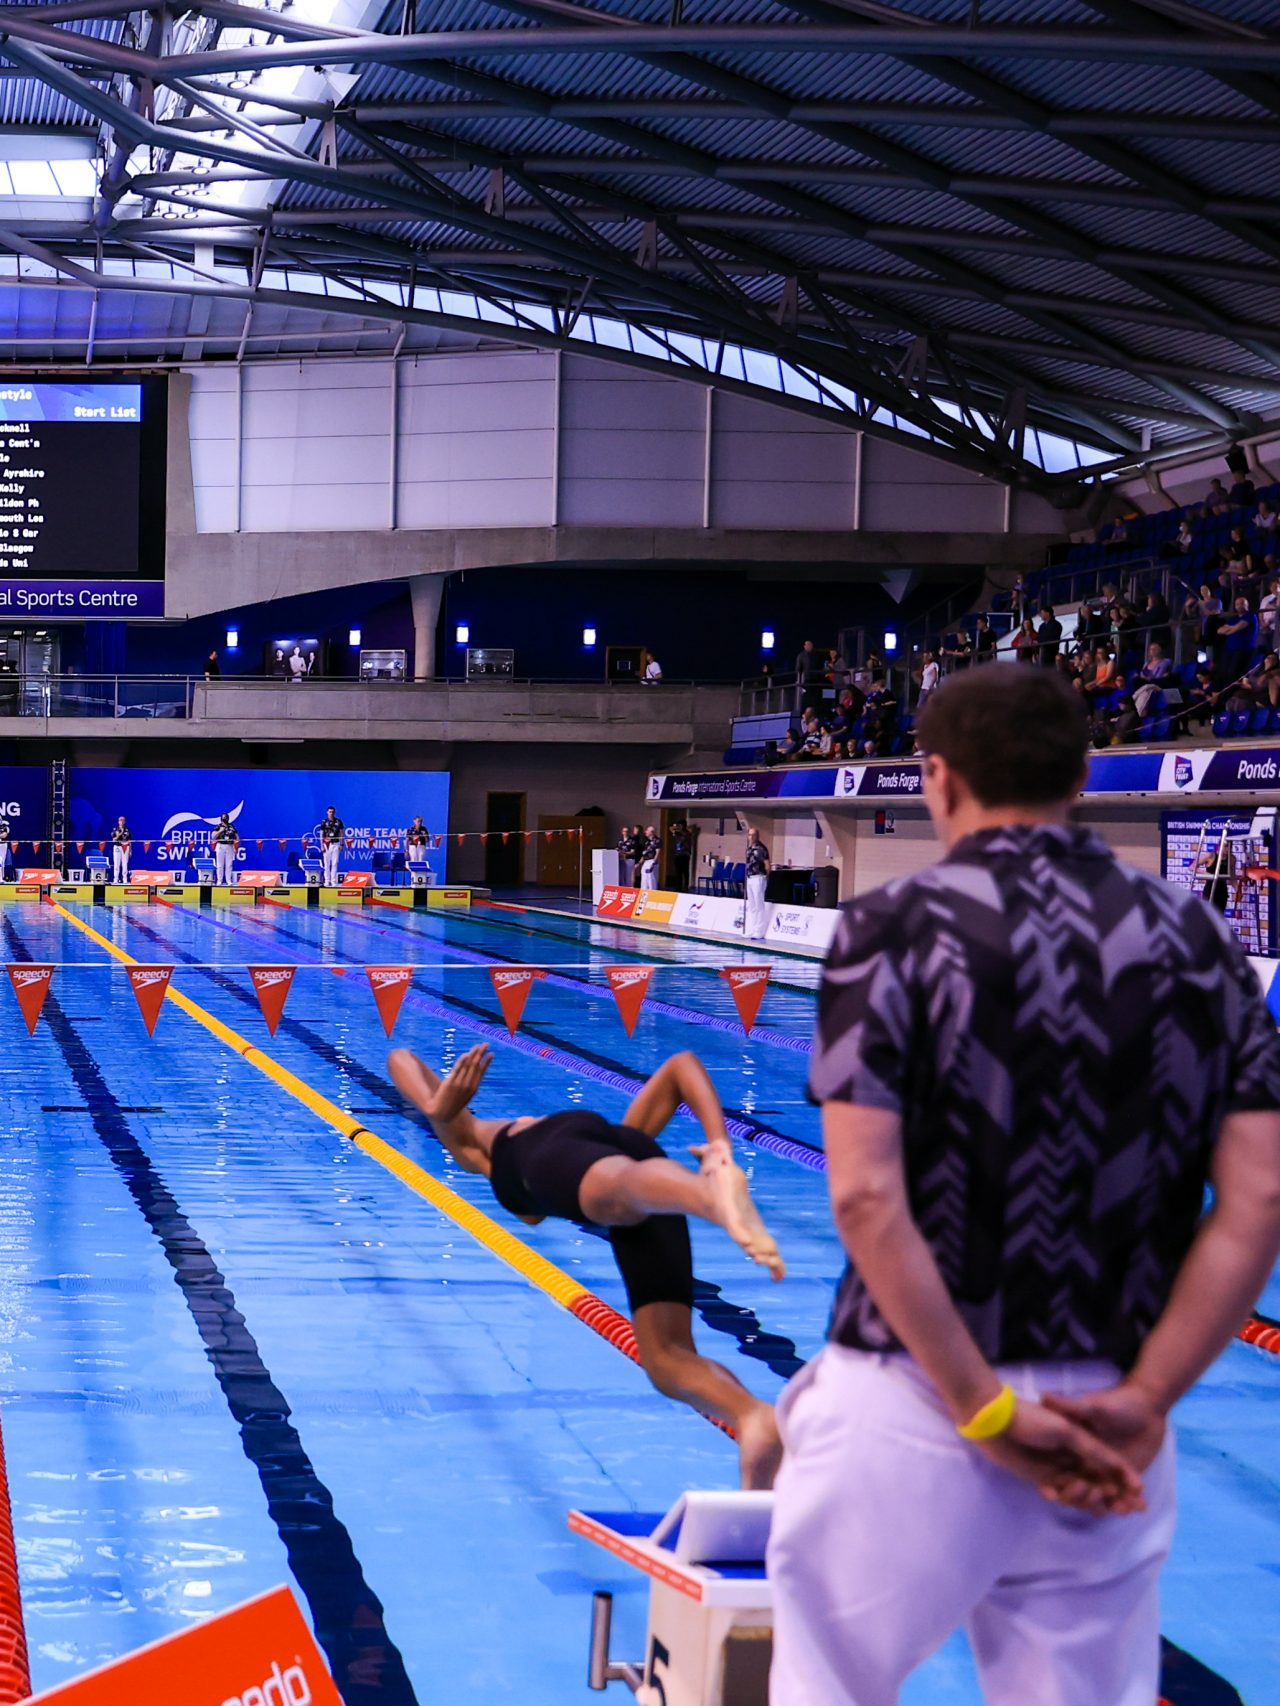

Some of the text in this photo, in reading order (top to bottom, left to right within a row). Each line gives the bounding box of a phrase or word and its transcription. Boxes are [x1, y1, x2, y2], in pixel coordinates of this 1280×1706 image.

[74, 406, 136, 417] Start List
[4, 469, 44, 479] Ayrshire
[16, 589, 74, 611] Sports
[79, 590, 138, 607] Centre
[1237, 758, 1277, 779] Ponds
[877, 772, 919, 791] Ponds Forge
[672, 781, 686, 793] Ponds
[686, 780, 698, 796] Forge
[345, 827, 371, 837] ONE
[13, 968, 50, 979] speedo
[132, 969, 169, 979] speedo
[254, 970, 292, 980] speedo
[371, 970, 409, 981] speedo
[494, 970, 531, 981] speedo
[611, 970, 649, 982] speedo
[730, 969, 767, 980] speedo
